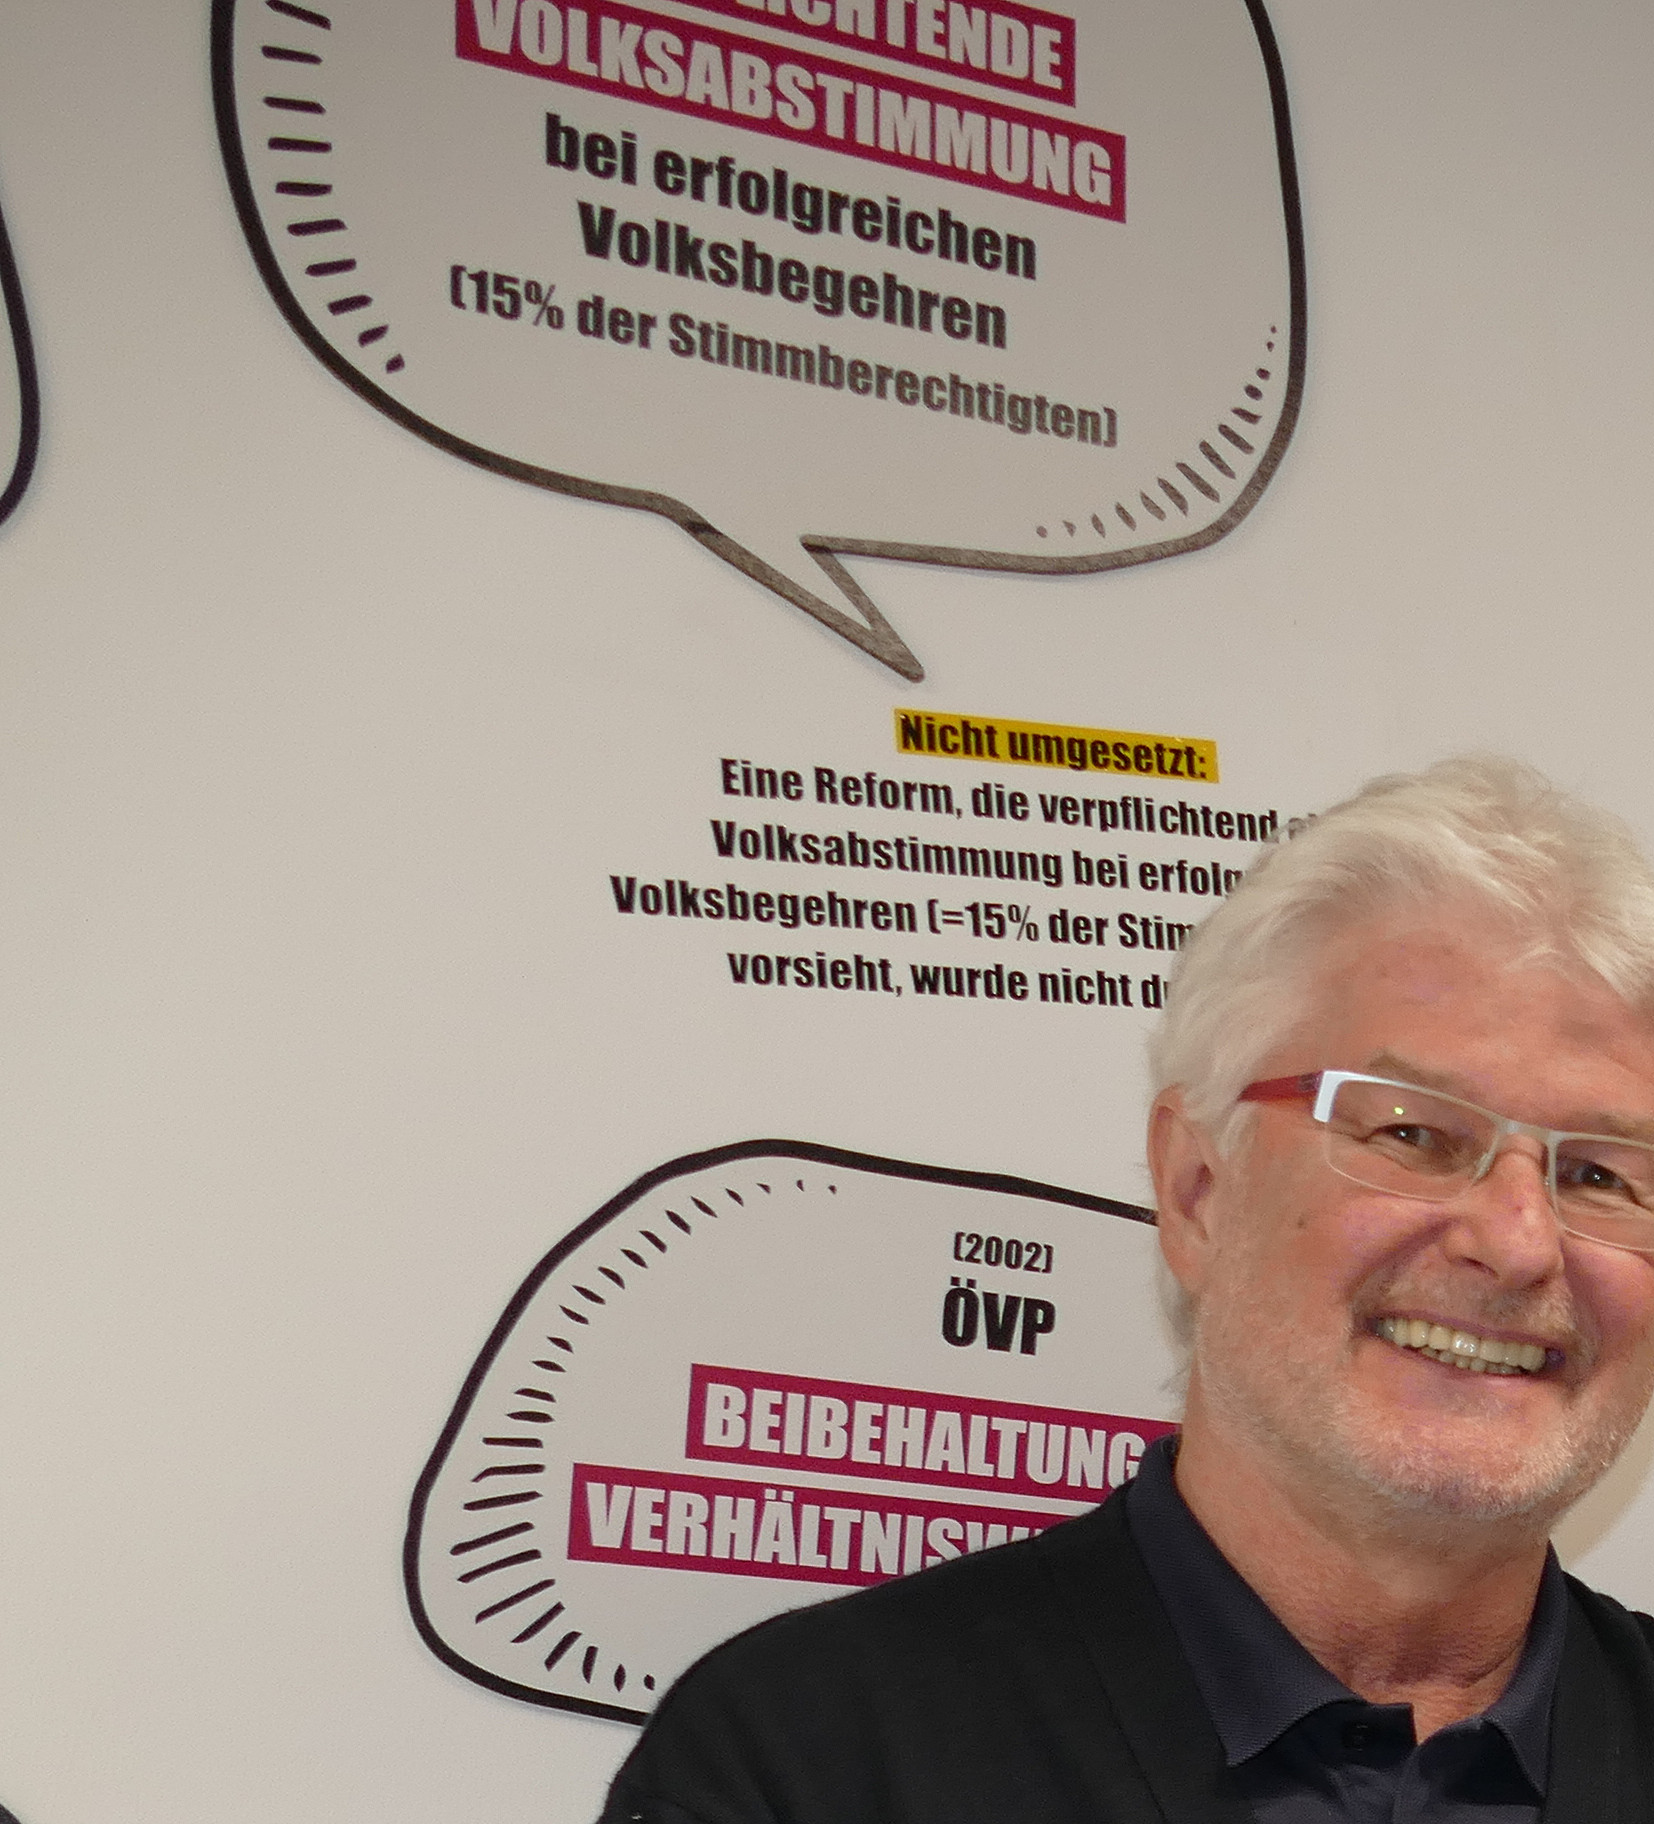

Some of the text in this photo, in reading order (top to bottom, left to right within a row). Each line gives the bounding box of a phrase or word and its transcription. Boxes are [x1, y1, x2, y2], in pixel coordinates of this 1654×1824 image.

[473, 0, 1111, 204] VOLKSABSTIMMUNG
[546, 112, 1036, 280] bei erfolgreichen
[578, 201, 1006, 348] Volksbegehren
[450, 265, 1116, 447] (15% der Stimmberechtigten)
[900, 714, 1206, 778] Nicht umgesetzt:
[721, 759, 803, 800] Eine
[815, 767, 961, 818] Reform,
[972, 783, 1029, 820] die
[1039, 794, 1278, 841] verpflichtend
[711, 820, 1129, 888] Volksabstimmung bei
[610, 876, 1108, 945] Volksbegehren (=15% der
[727, 953, 901, 997] vorsieht,
[910, 964, 1028, 1000] wurde
[1039, 968, 1133, 1007] nicht
[942, 1276, 1055, 1355] ÖVP
[703, 1382, 1146, 1489] BEIBEHALTUNG
